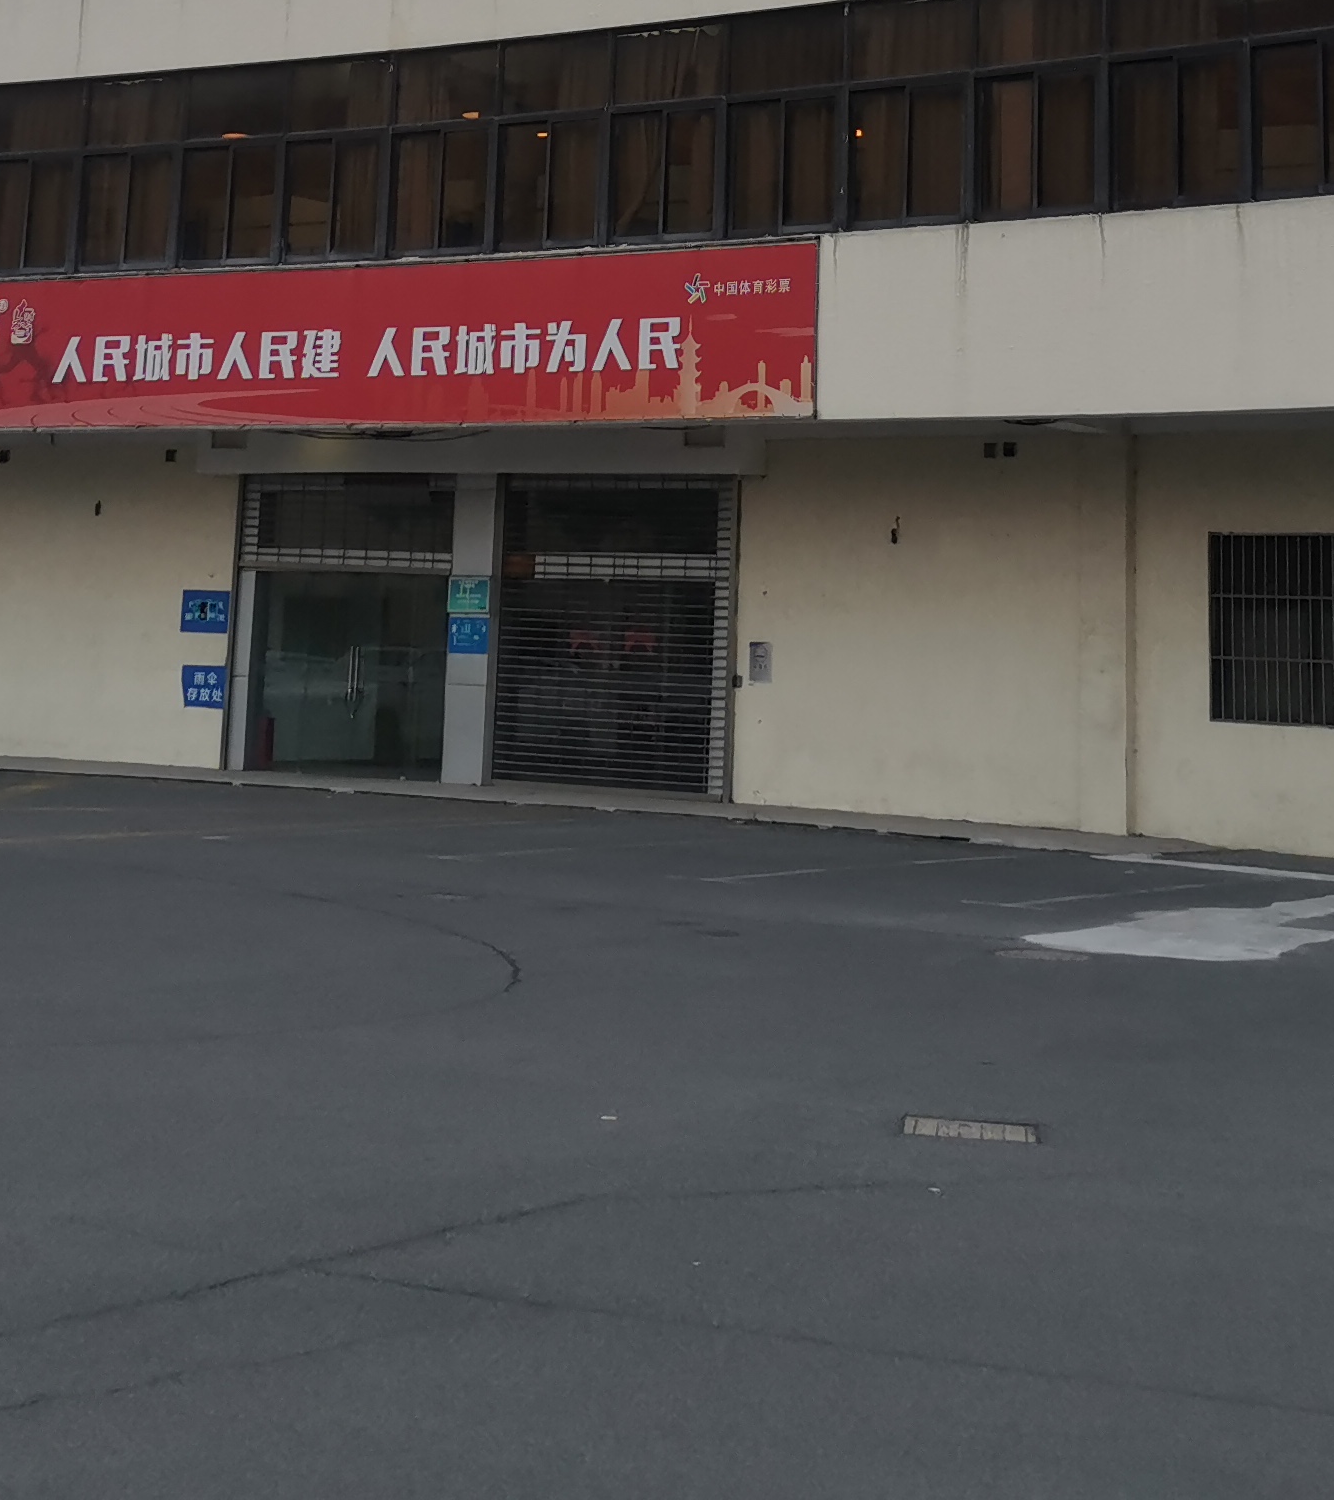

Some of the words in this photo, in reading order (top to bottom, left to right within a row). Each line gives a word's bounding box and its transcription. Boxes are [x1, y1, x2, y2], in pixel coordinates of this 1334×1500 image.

[713, 278, 791, 297] 中国体育彩票
[52, 329, 341, 383] 人民城市人民建
[367, 317, 681, 377] 人民城市为人民
[193, 671, 217, 686] 雨伞
[186, 686, 222, 702] 存放处
